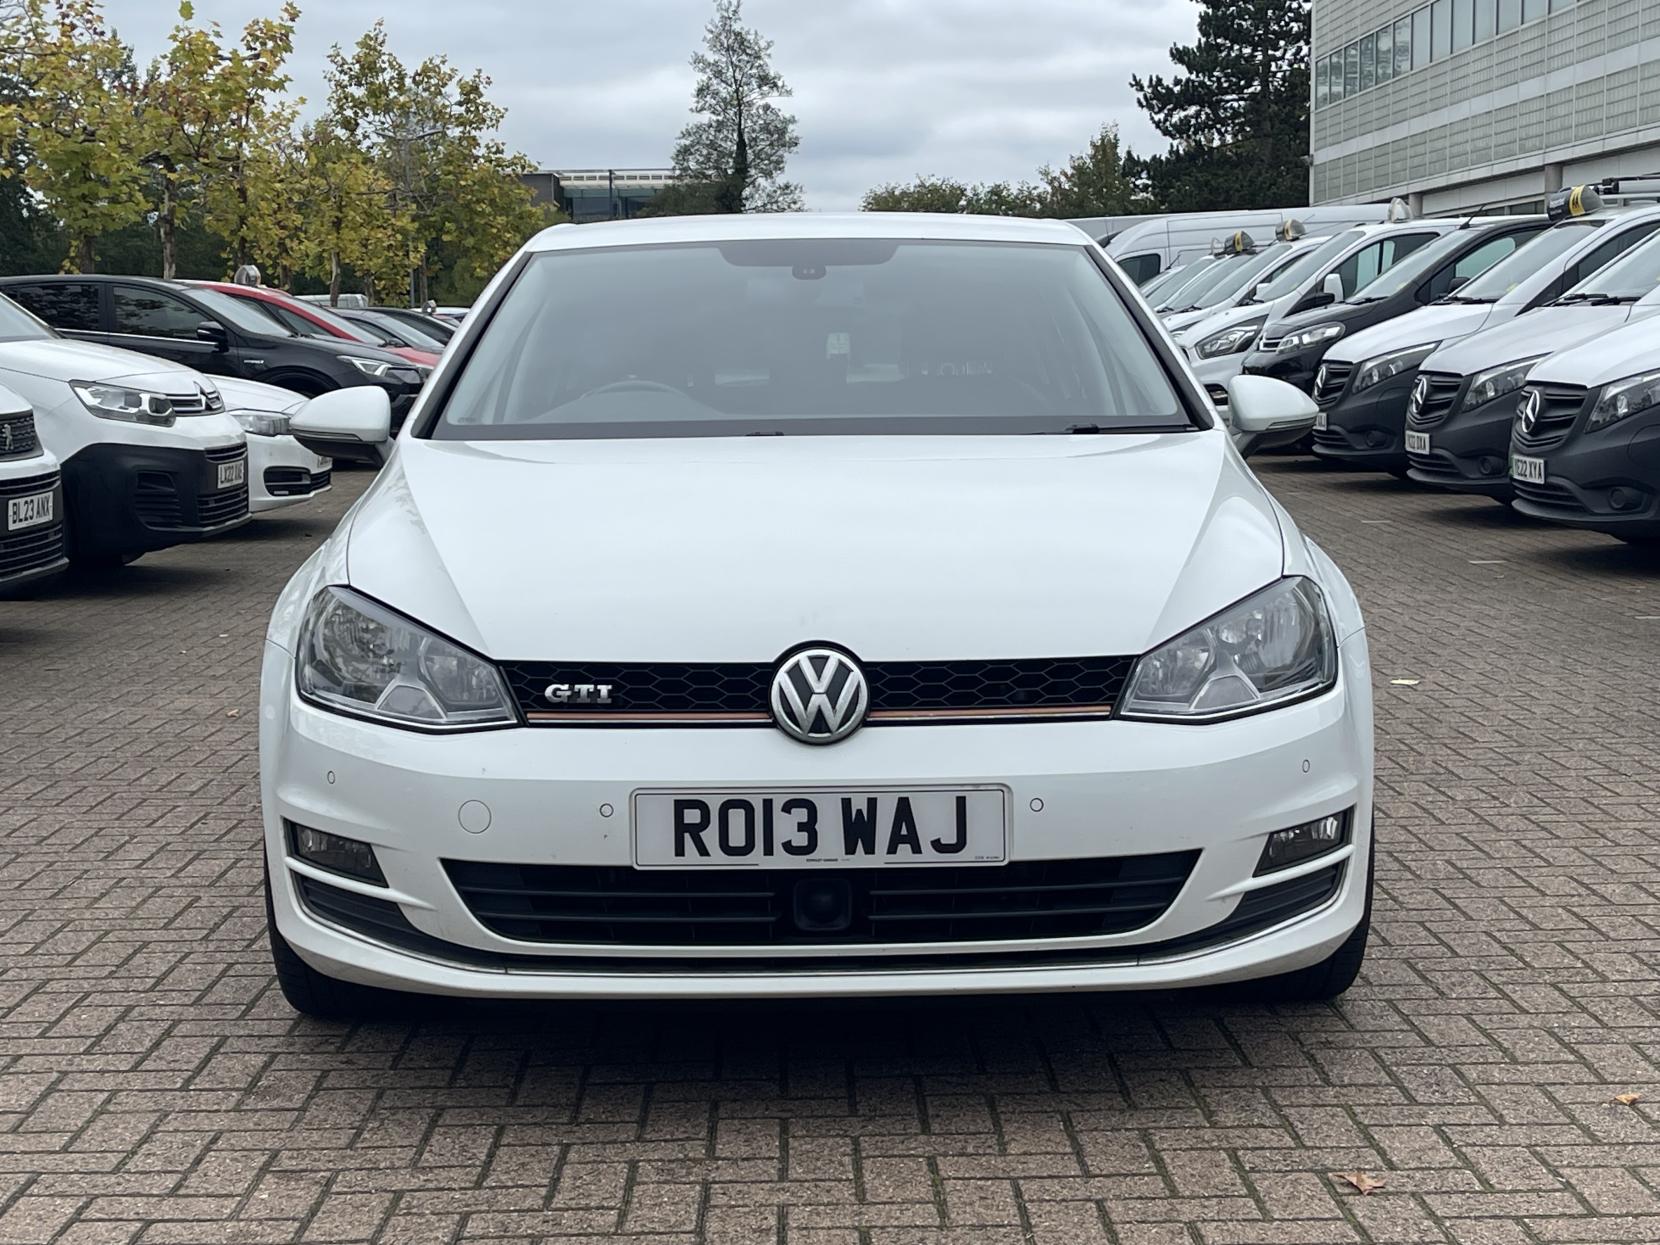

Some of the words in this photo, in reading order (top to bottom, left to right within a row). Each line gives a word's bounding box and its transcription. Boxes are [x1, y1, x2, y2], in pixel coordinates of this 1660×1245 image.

[12, 499, 35, 524] BL23
[36, 494, 51, 519] ANX
[544, 684, 612, 703] GTI
[673, 798, 818, 857] RO13
[841, 796, 967, 856] WAJ
